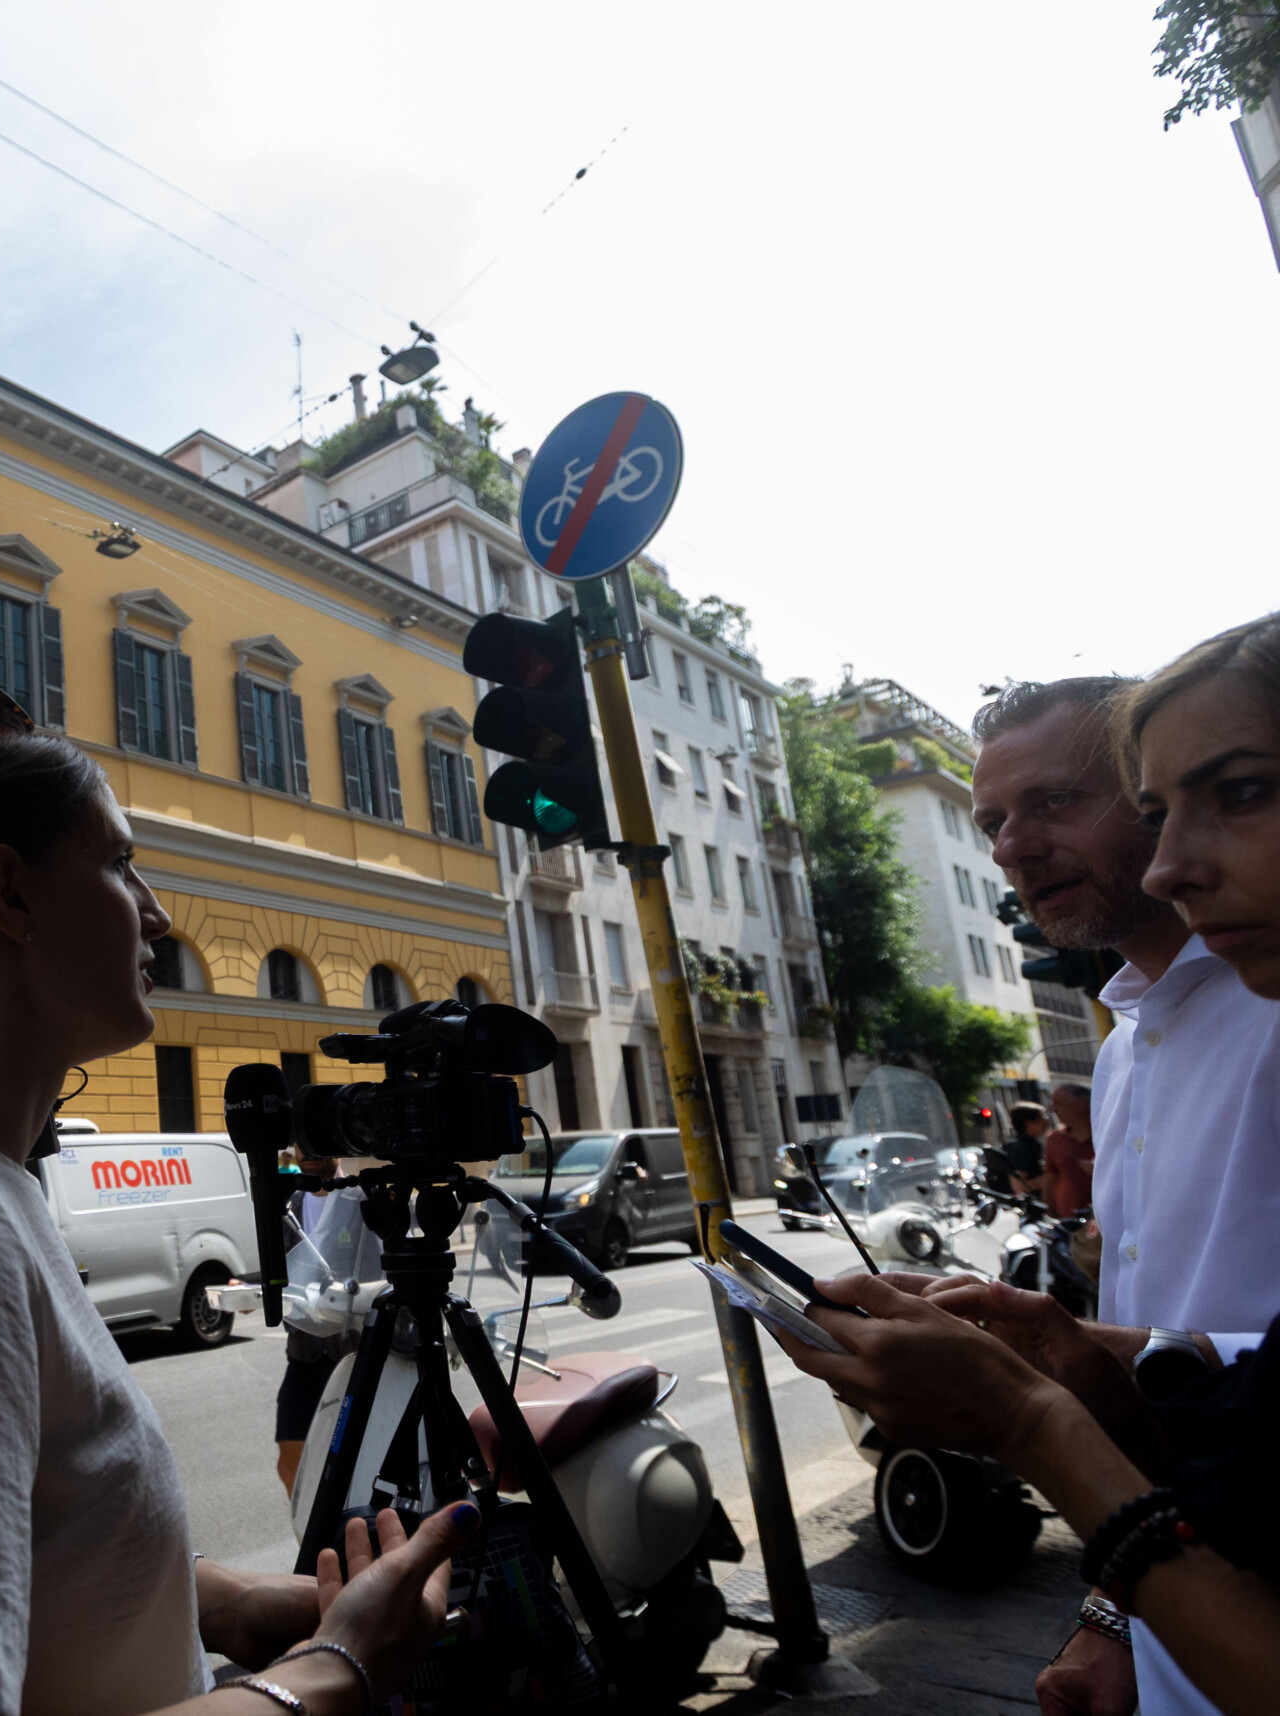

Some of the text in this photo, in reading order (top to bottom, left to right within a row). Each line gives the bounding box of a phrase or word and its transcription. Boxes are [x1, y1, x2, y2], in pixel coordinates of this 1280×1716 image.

[241, 1099, 253, 1110] 24
[161, 1147, 183, 1157] RENT
[91, 1158, 192, 1190] MORINI
[97, 1189, 171, 1206] freezer
